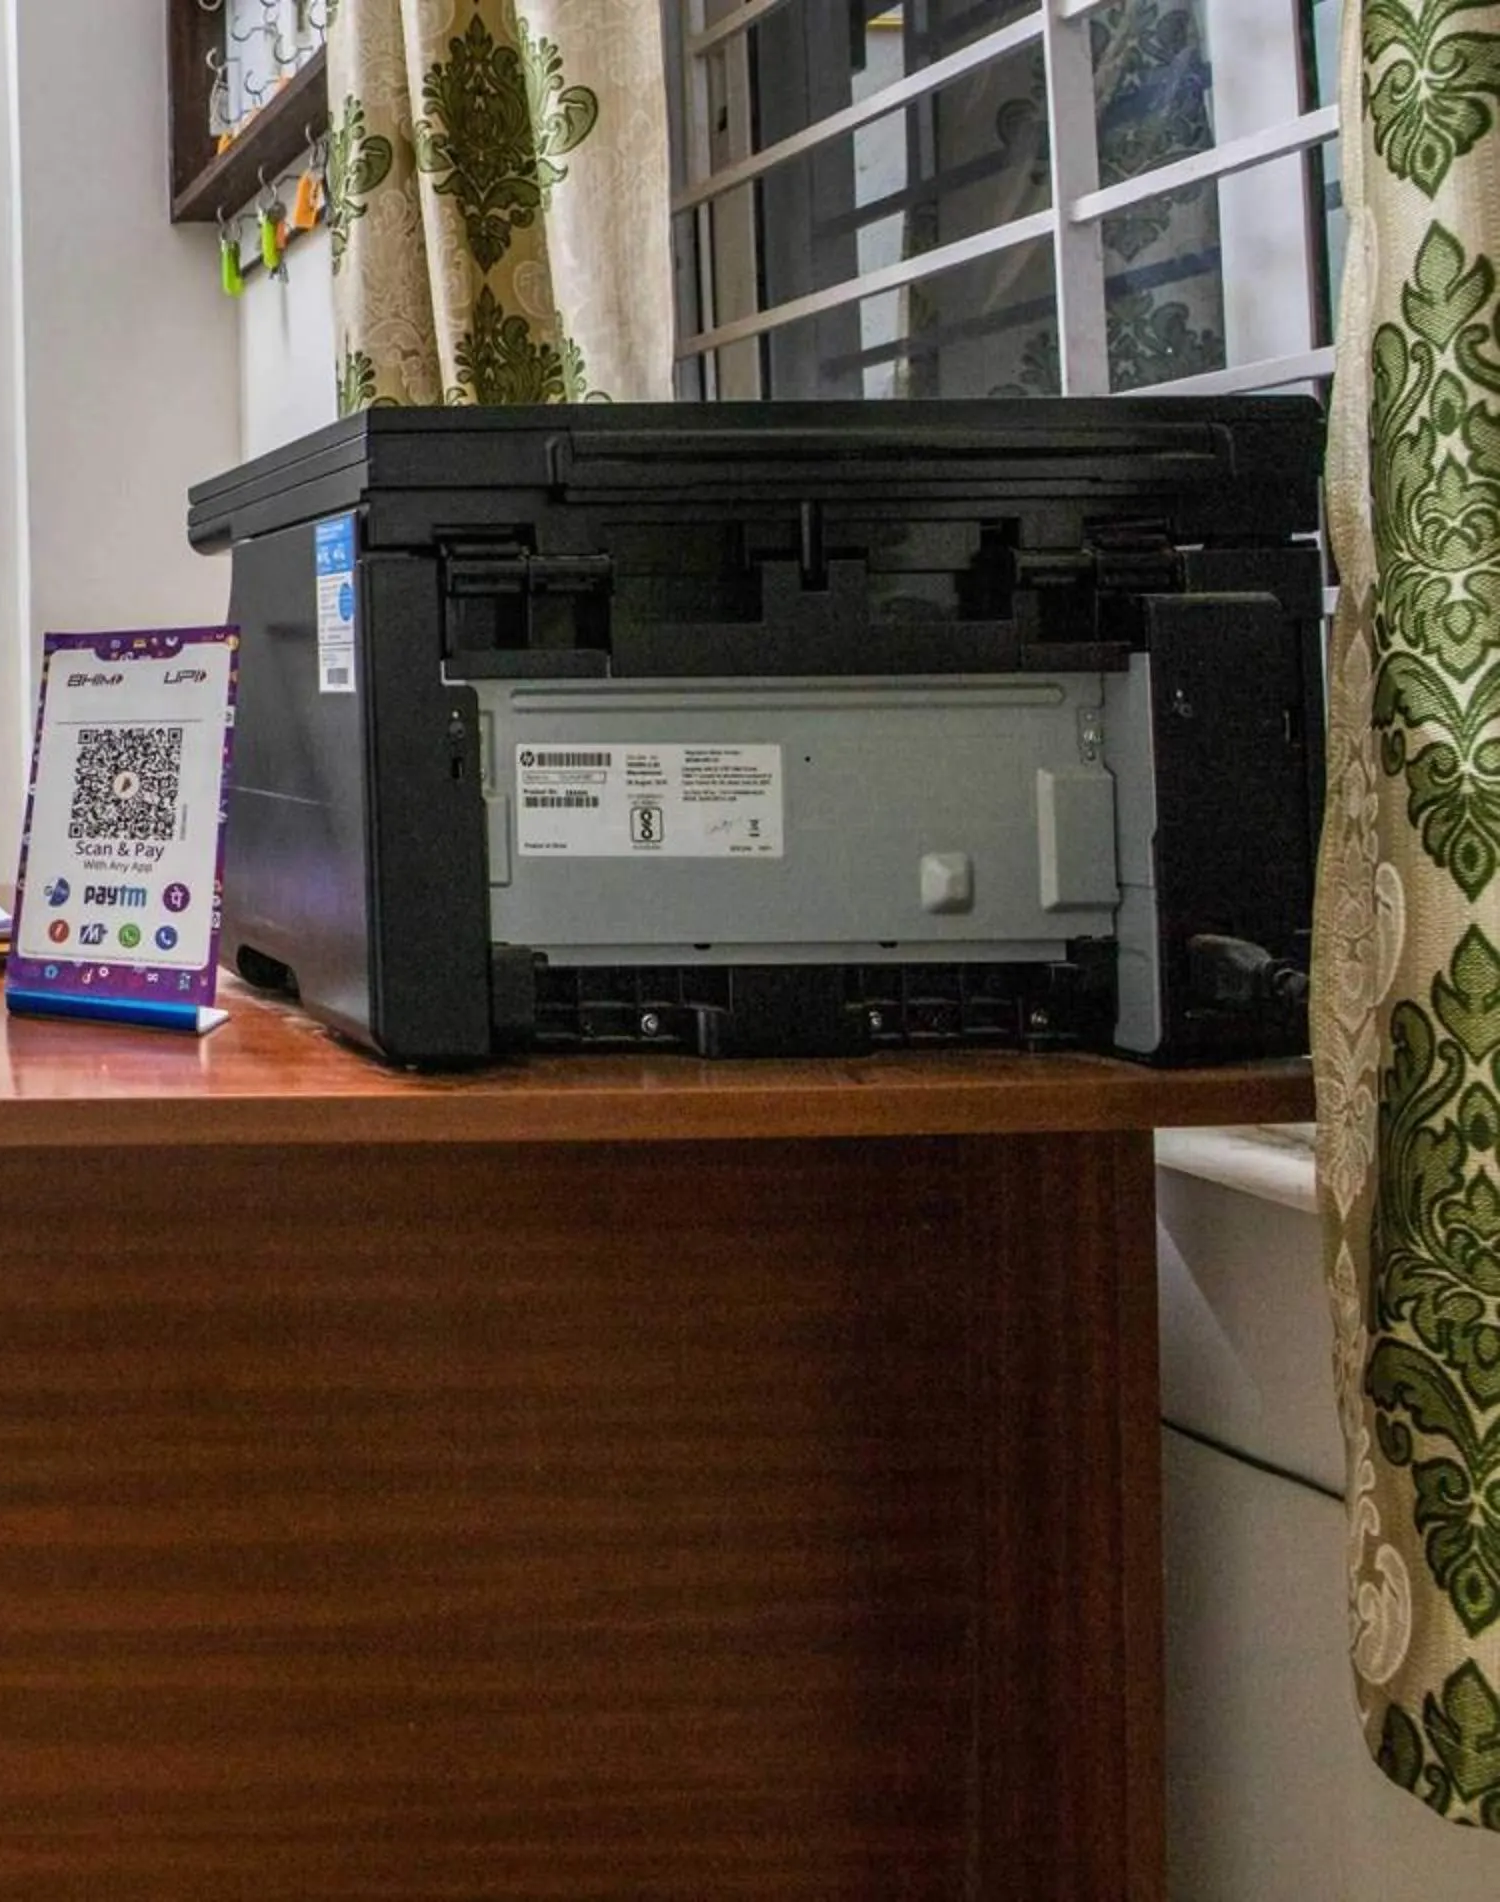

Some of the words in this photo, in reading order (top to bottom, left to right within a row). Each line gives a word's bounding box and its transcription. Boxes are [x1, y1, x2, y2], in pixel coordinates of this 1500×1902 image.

[75, 841, 113, 856] Scan
[117, 841, 130, 857] &
[135, 842, 165, 862] Pay
[83, 861, 107, 871] With
[109, 861, 130, 873] Any
